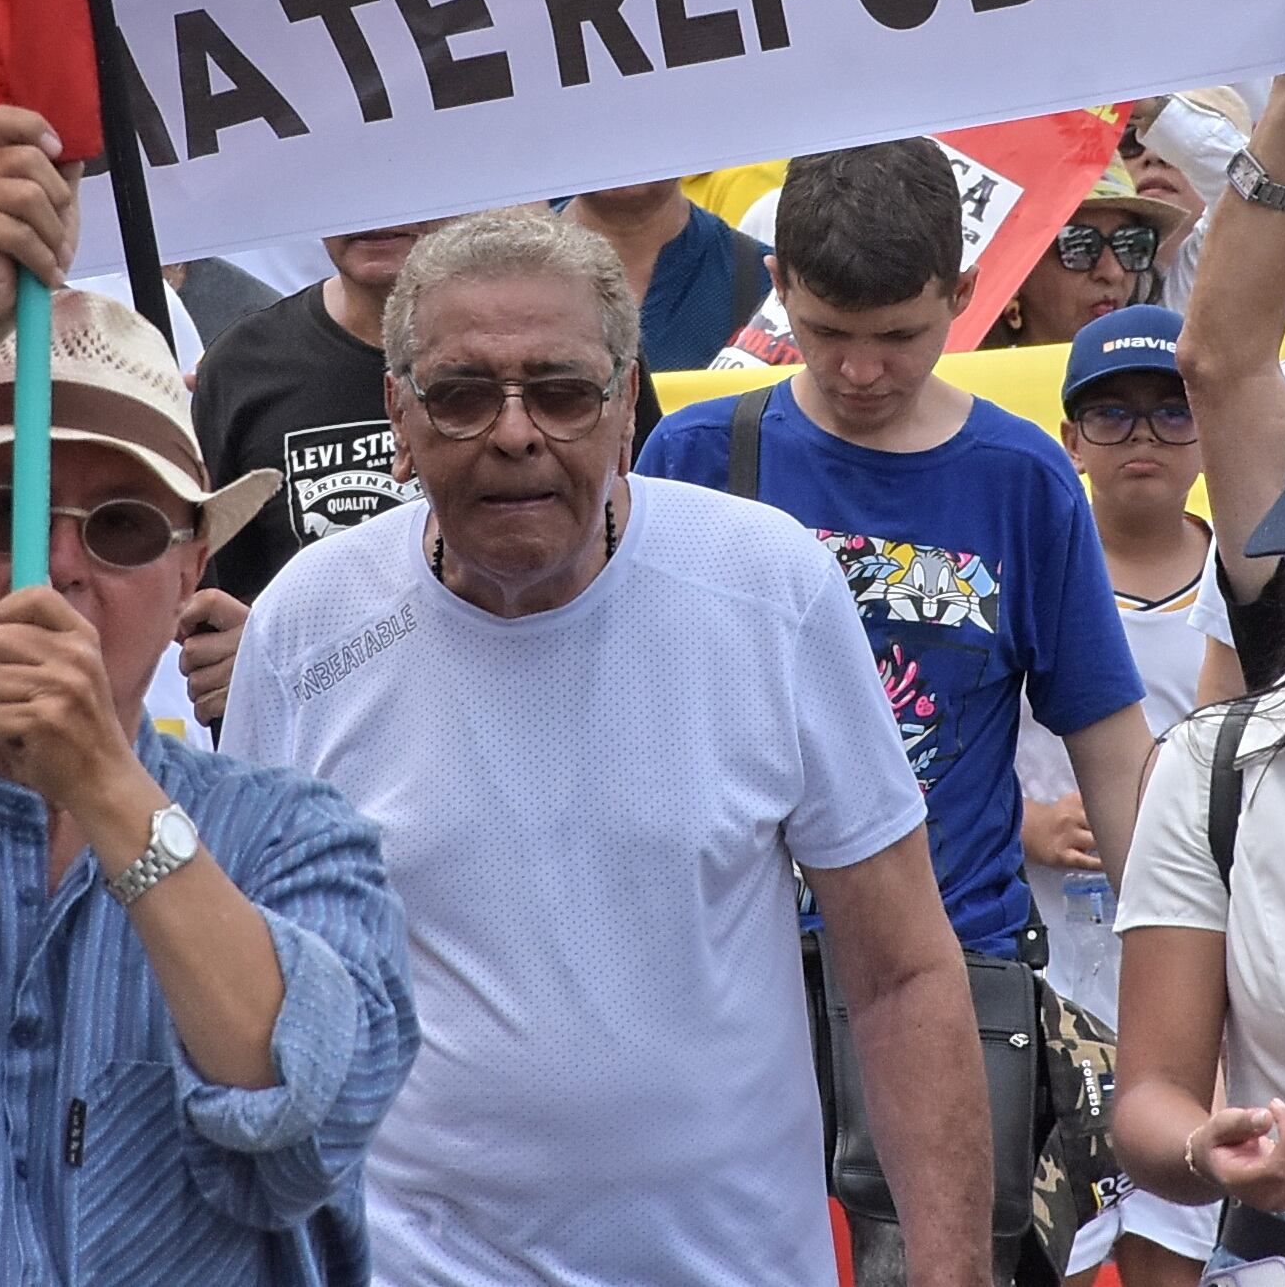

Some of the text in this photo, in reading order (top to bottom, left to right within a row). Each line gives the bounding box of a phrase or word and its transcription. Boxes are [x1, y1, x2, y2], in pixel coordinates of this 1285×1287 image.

[291, 443, 343, 473] LEVI
[304, 475, 404, 501] ORIGINAL
[327, 496, 379, 514] QUALITY
[1082, 1059, 1100, 1116] CONCEJO
